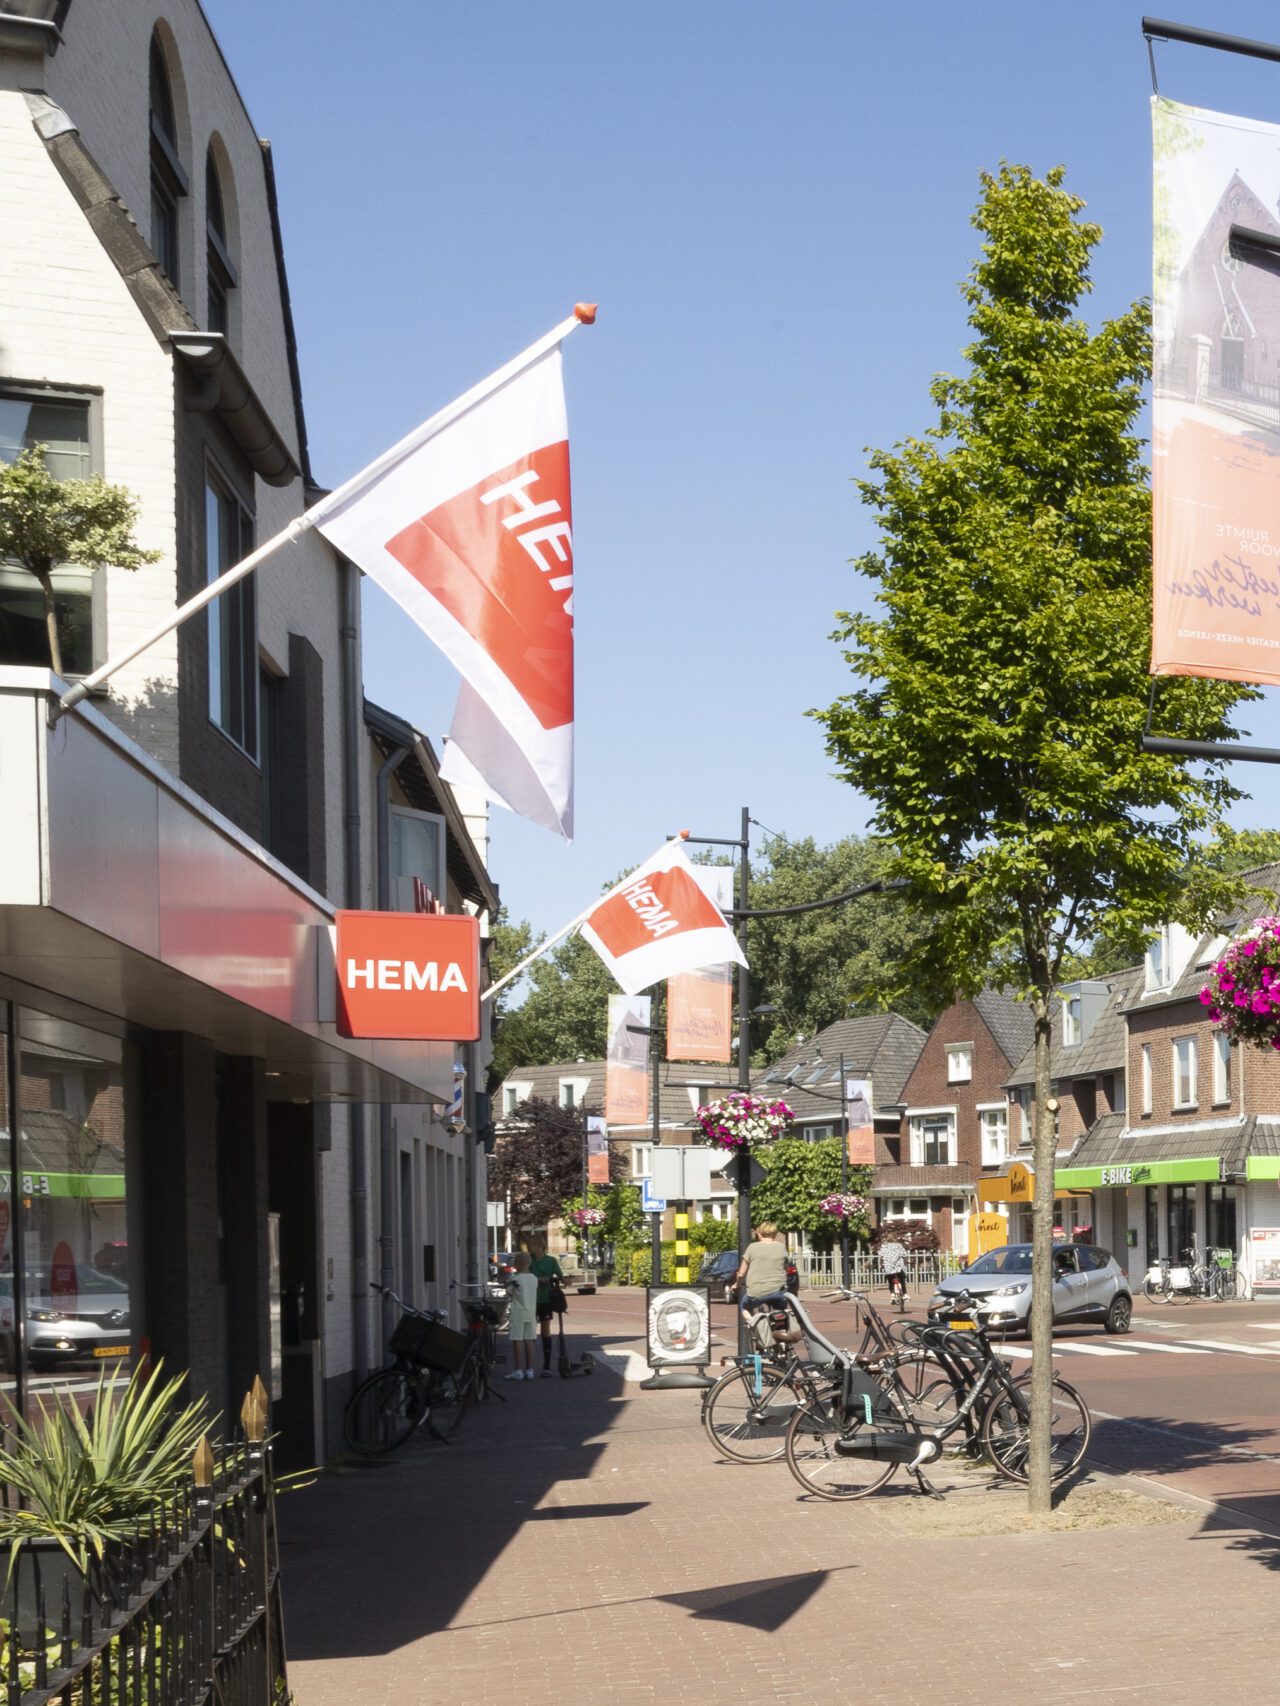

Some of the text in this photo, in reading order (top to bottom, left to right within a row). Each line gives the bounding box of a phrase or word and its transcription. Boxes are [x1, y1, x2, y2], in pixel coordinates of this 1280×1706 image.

[620, 879, 680, 938] HEMA
[347, 959, 468, 992] HEMA
[1101, 1167, 1132, 1185] E-BIKE
